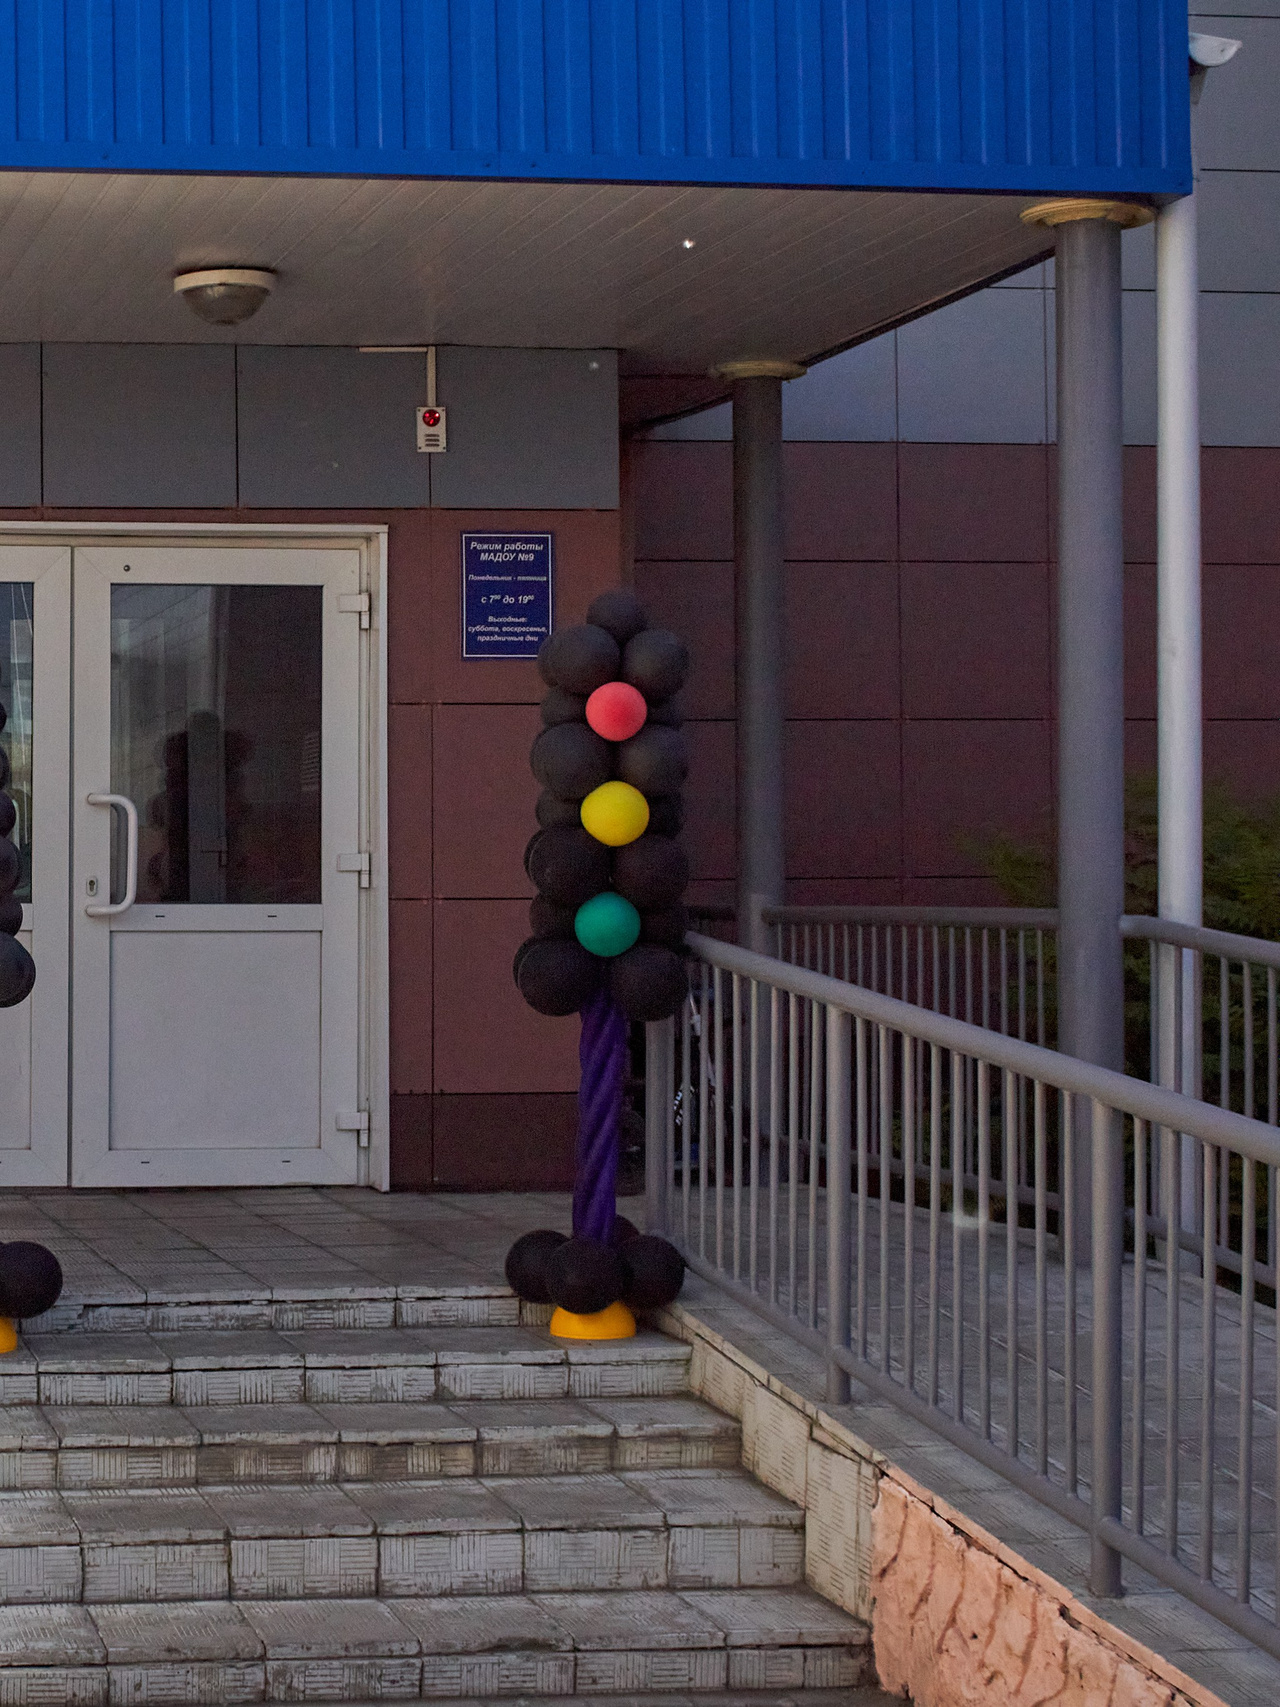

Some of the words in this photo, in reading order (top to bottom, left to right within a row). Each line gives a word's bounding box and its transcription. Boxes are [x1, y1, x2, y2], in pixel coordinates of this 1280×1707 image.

[471, 542, 502, 550] Режим
[504, 542, 543, 551] работы
[480, 553, 515, 562] МАДОУ
[518, 553, 534, 561] №9
[503, 595, 515, 603] до
[468, 625, 500, 633] суббота,
